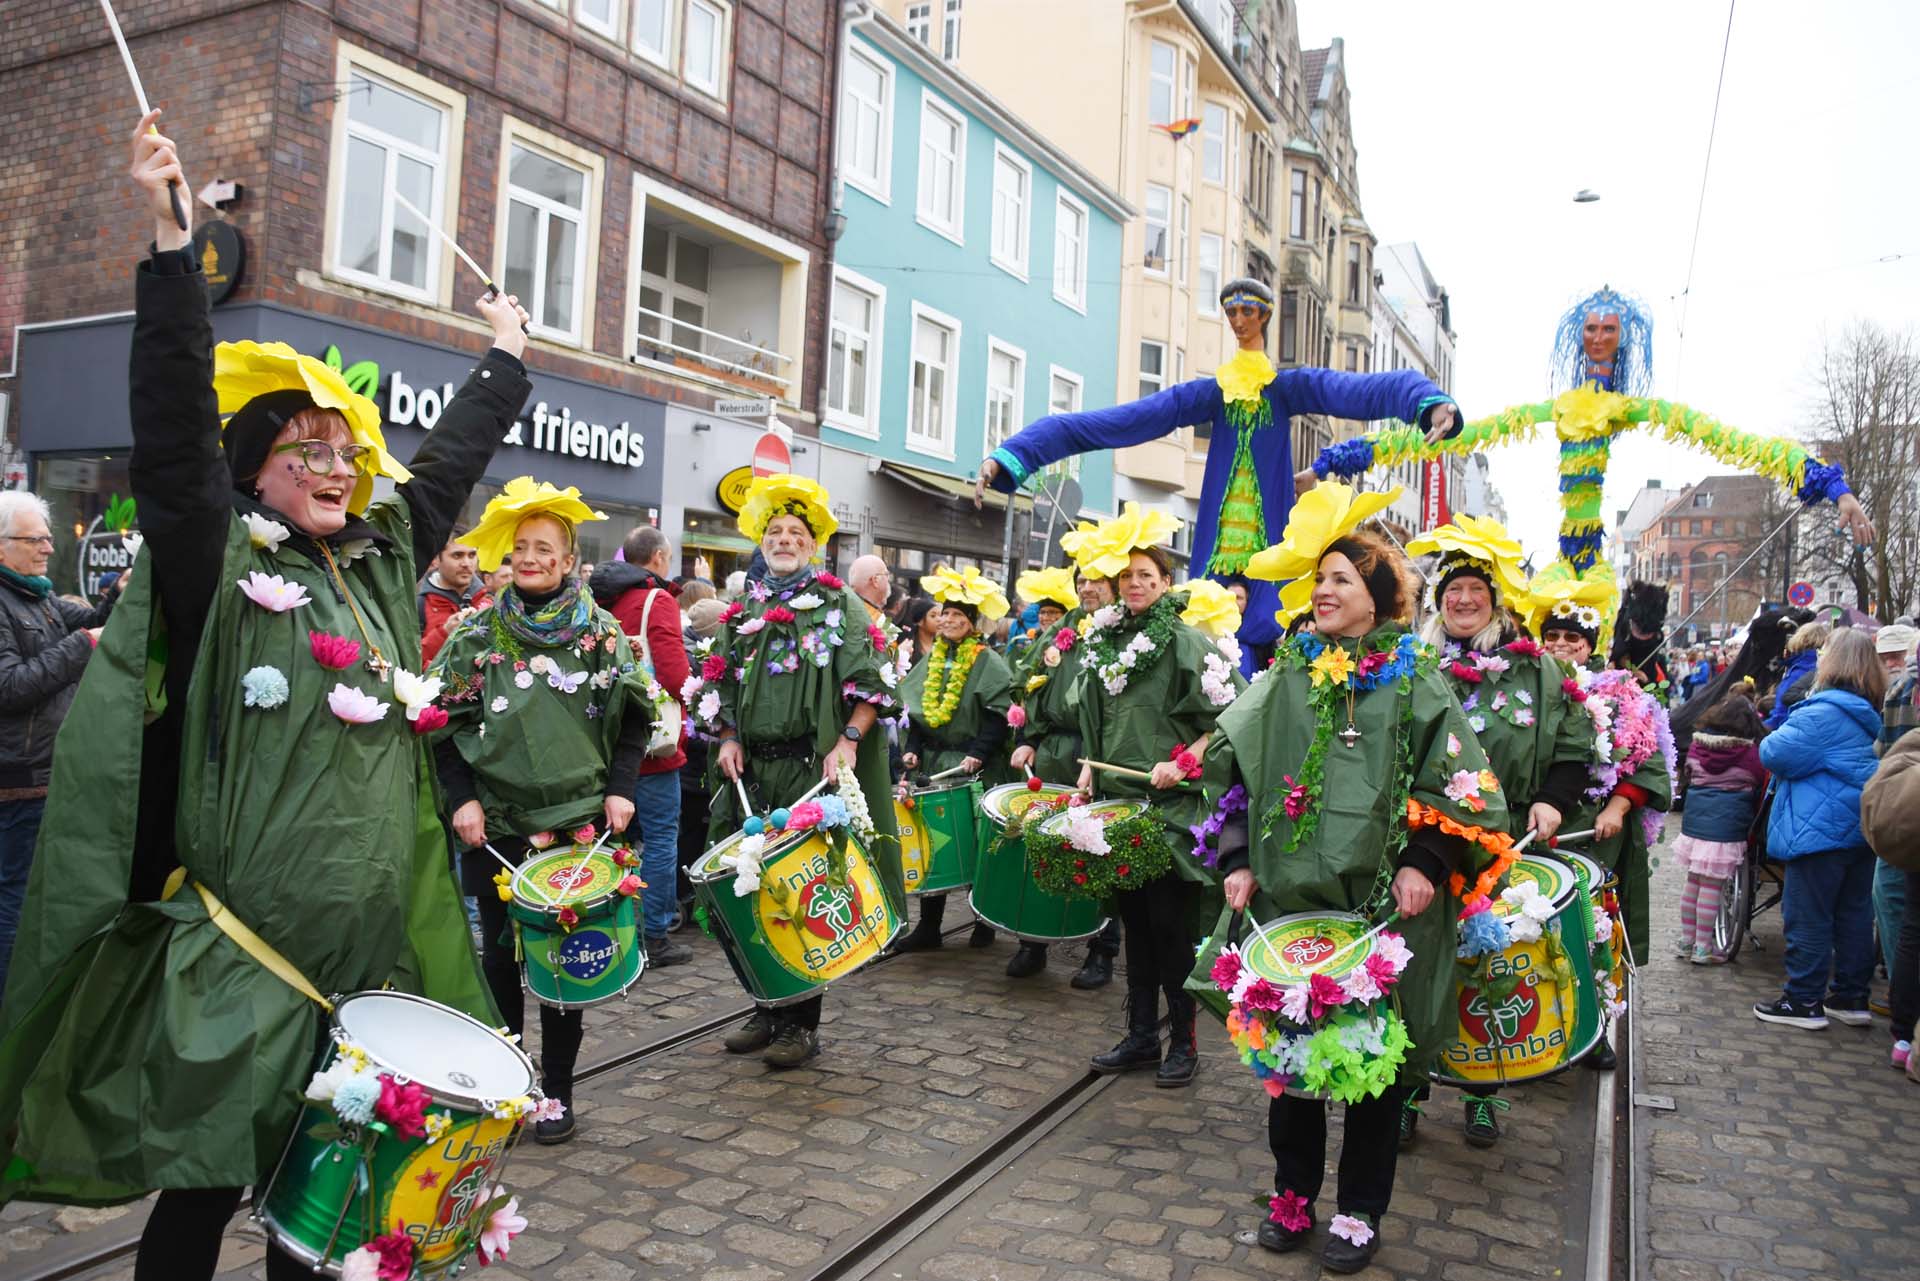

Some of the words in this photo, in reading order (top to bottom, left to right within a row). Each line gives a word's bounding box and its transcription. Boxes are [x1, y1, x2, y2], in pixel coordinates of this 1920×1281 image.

[719, 403, 764, 413] Weberstraße
[532, 402, 645, 468] friends
[89, 543, 128, 568] boba
[803, 904, 885, 971] Samba
[1448, 1027, 1567, 1064] Samba
